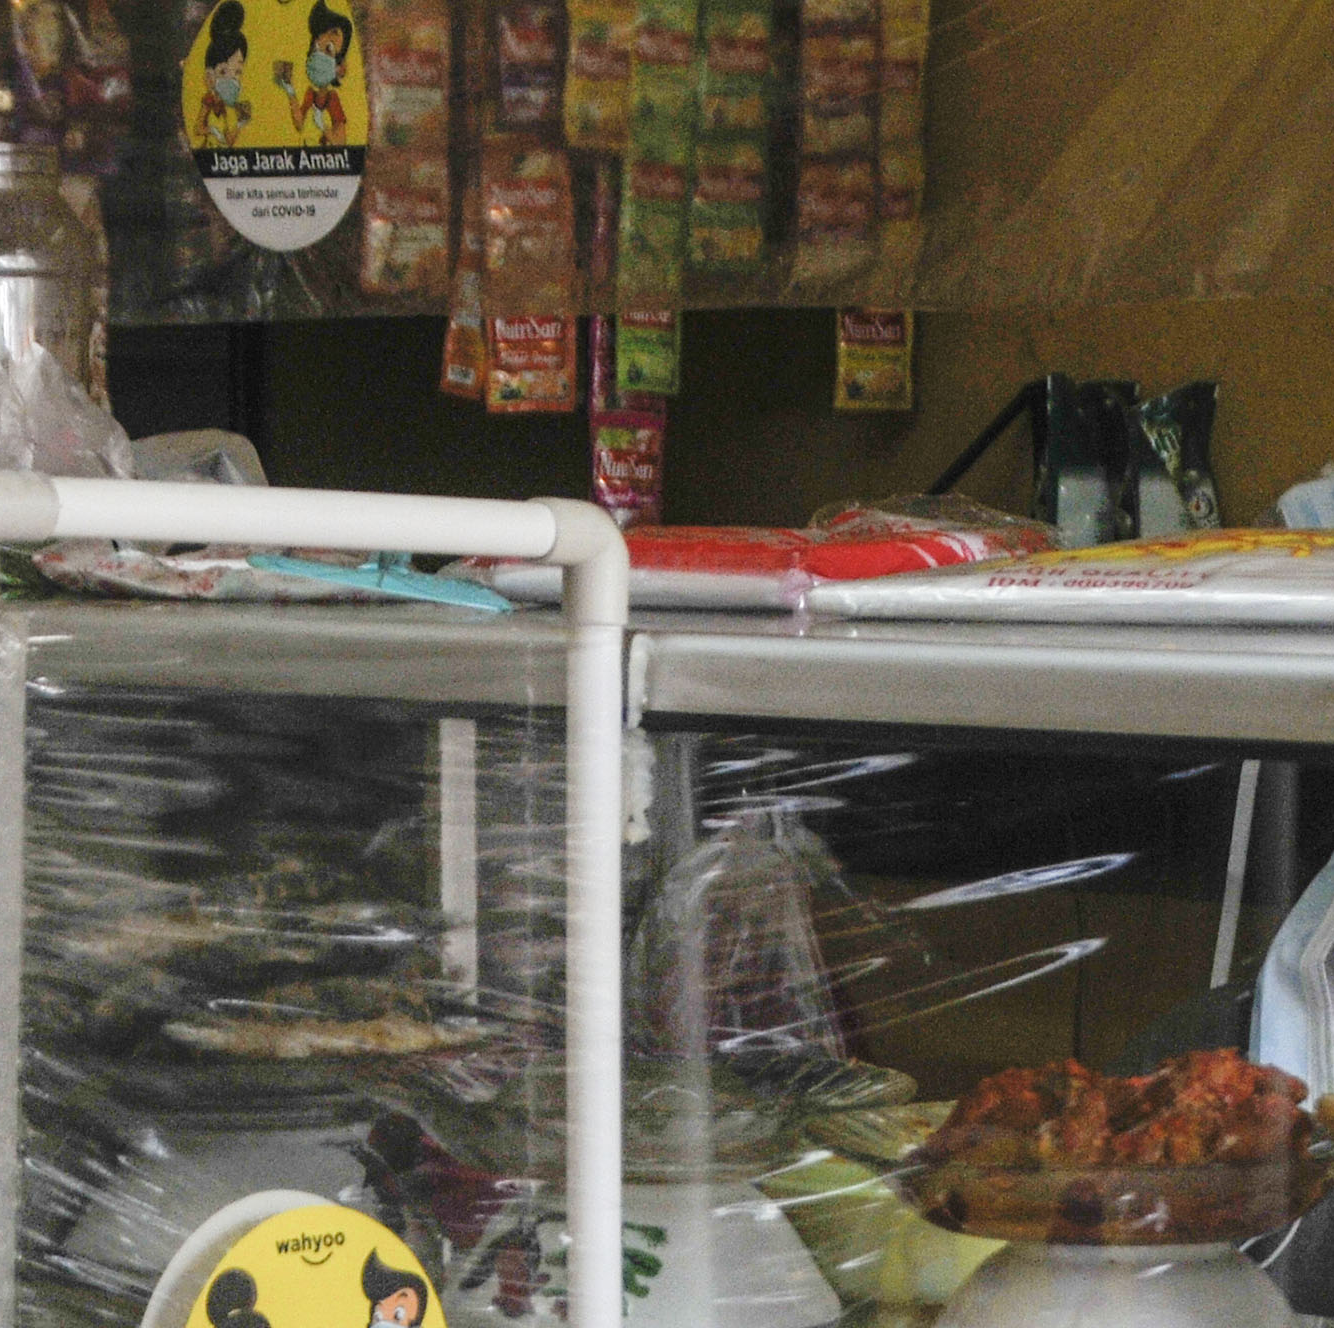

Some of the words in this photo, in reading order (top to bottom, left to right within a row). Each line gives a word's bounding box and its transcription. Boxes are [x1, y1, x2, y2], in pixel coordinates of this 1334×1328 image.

[210, 152, 248, 175] Jaga
[252, 150, 295, 171] Jarak
[298, 148, 351, 170] Aman!
[247, 187, 264, 200] kita
[271, 204, 316, 217] COVID-19
[275, 1230, 347, 1256] wahyoo
